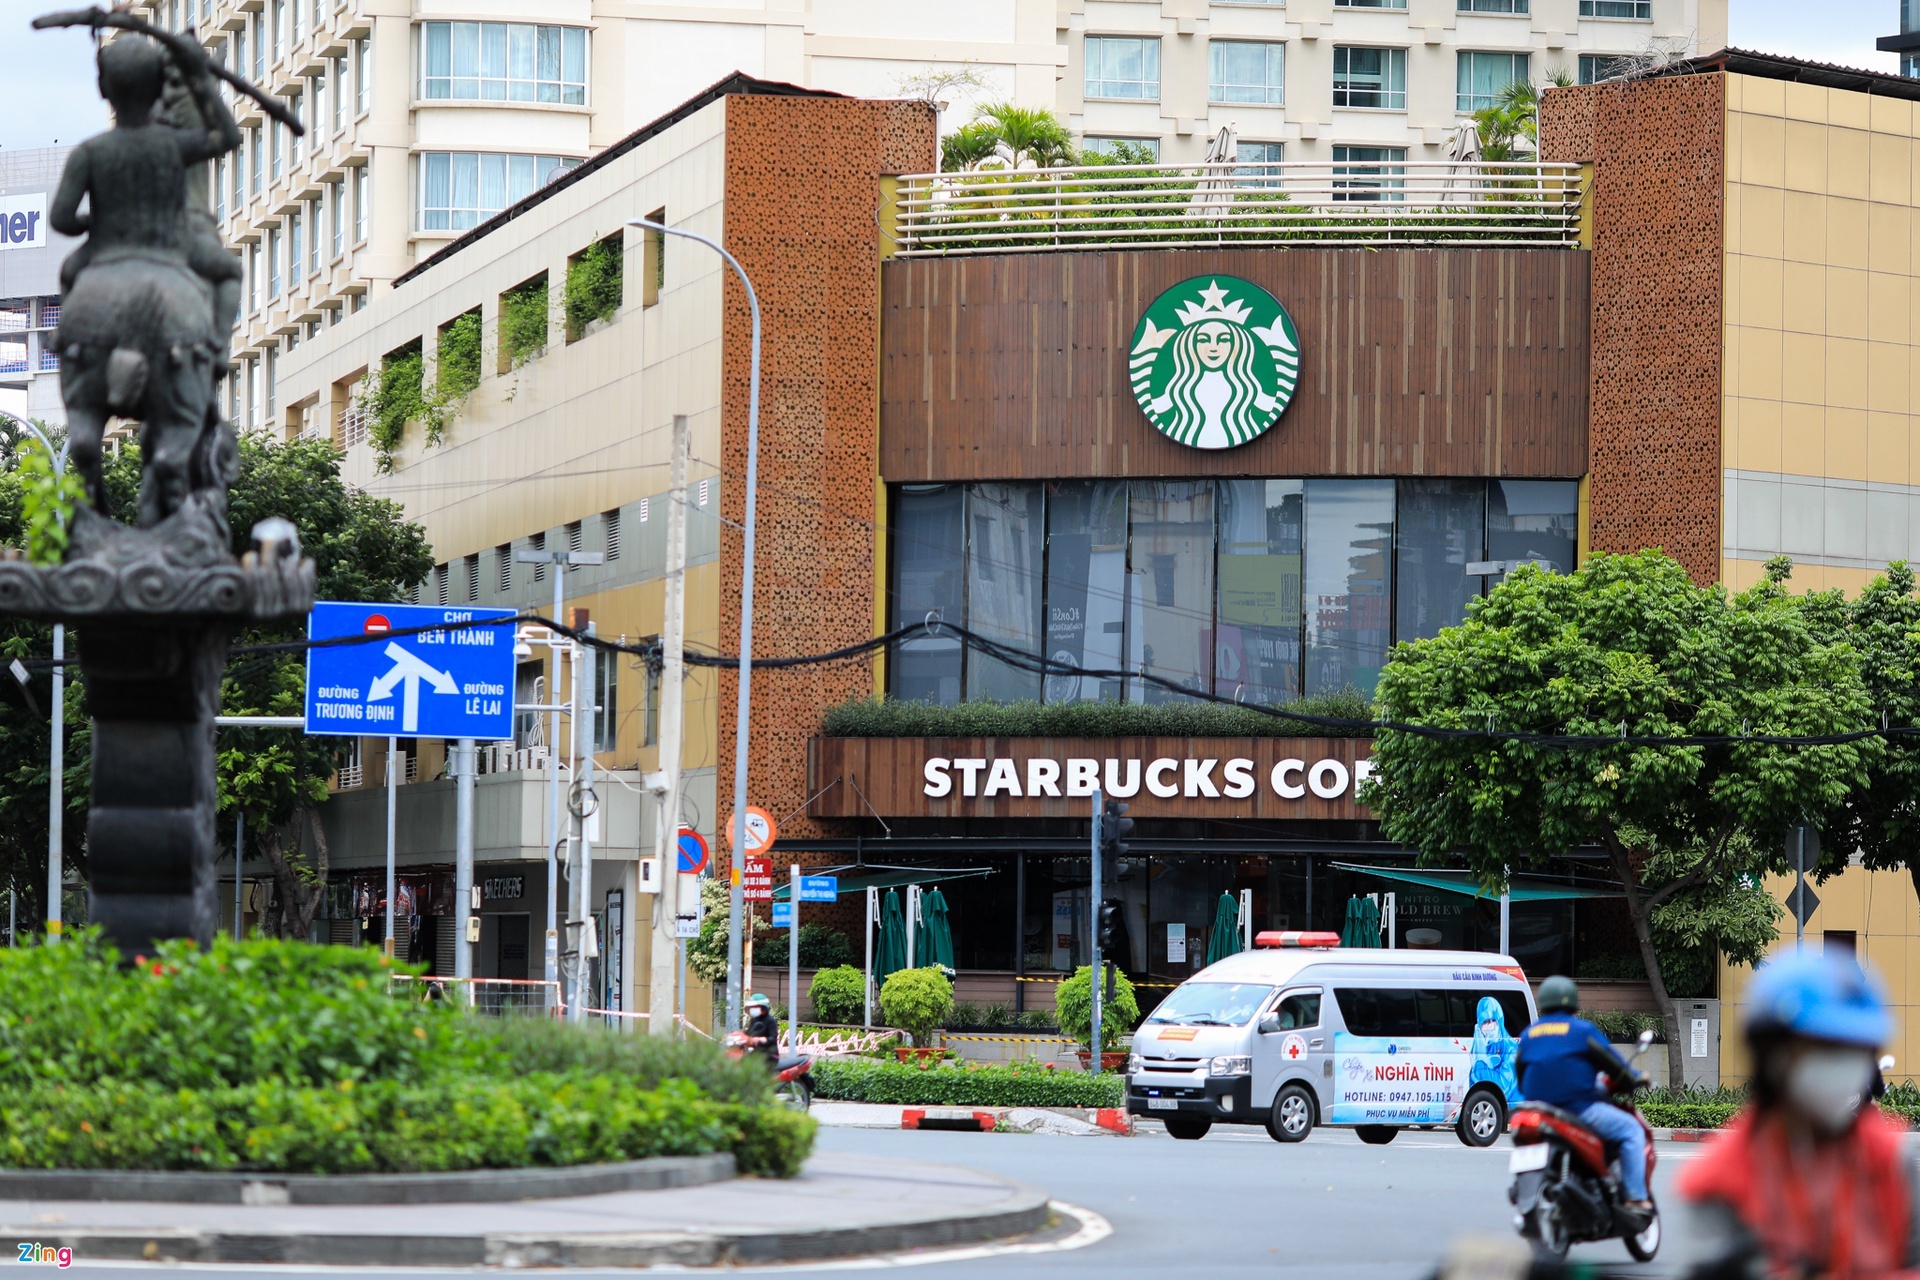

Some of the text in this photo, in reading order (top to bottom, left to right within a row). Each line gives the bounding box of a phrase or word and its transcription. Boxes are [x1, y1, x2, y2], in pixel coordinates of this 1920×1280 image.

[450, 628, 495, 646] THÀNH
[318, 684, 359, 699] ĐƯỜNG
[463, 681, 504, 696] ĐƯỜNG
[315, 702, 395, 722] TRƯƠNG ĐỊNH
[465, 697, 501, 715] LÊ LAI
[923, 757, 1256, 799] STARBUCKS
[743, 860, 764, 873] ẤM
[1423, 905, 1463, 915] BREW
[1375, 1062, 1454, 1081] NGHĨA TÌNH
[1344, 1092, 1452, 1102] HOTLINE: 0947.105.115
[1366, 1107, 1430, 1119] PHỤC VỤ MIỄN PHÍ
